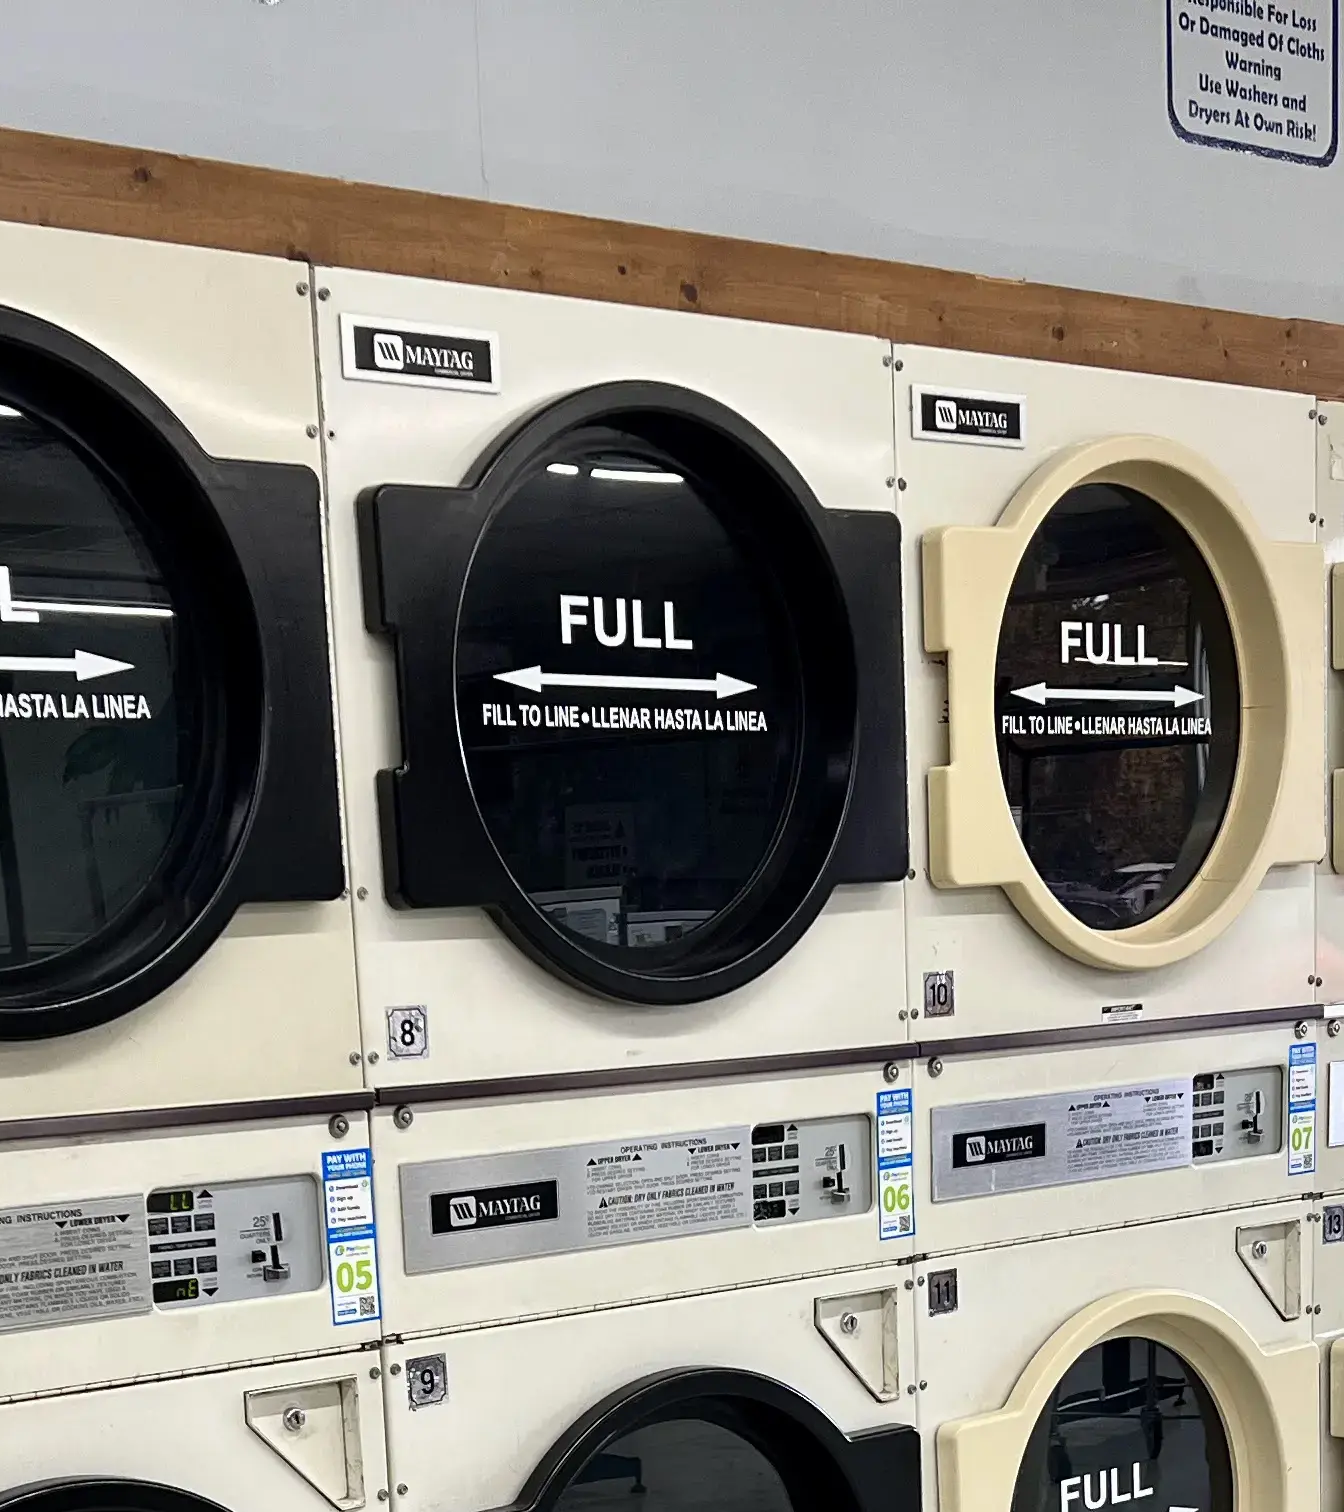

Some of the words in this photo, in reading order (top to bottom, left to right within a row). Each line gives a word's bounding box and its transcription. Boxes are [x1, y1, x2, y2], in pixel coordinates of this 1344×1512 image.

[1267, 4, 1289, 25] For
[1292, 9, 1317, 32] Loss
[1178, 12, 1196, 33] Or
[1200, 16, 1265, 49] Damaged
[1268, 32, 1284, 52] Of
[1287, 37, 1325, 62] Cloths
[1225, 50, 1282, 82] Warning
[1199, 73, 1222, 95] Use
[1226, 78, 1278, 107] Washers
[1282, 95, 1307, 113] and
[1188, 99, 1231, 125] Dryers
[1234, 109, 1250, 128] At
[1253, 113, 1283, 136] Own
[1286, 119, 1317, 143] Risk!
[406, 345, 473, 370] MAYTAG
[958, 409, 1007, 429] MAYTAG
[560, 594, 693, 650] FULL
[1061, 621, 1158, 666] FULL
[61, 694, 89, 719] LA
[92, 694, 151, 719] LINEA
[482, 703, 517, 726] FILL
[519, 704, 541, 727] TO
[544, 705, 580, 728] LINE
[591, 706, 652, 729] LLENAR
[654, 708, 703, 730] HASTA
[705, 710, 723, 731] LA
[726, 710, 768, 732] LINEA
[1002, 715, 1026, 734] FILL
[1029, 716, 1045, 734] TO
[1048, 716, 1073, 734] LINE
[1081, 716, 1126, 735] LLENAR
[1128, 717, 1164, 735] HASTA
[1165, 717, 1180, 735] LA
[1181, 717, 1212, 735] LINEA
[929, 983, 948, 1007] 10
[399, 1019, 415, 1049] 8
[987, 1135, 1033, 1154] MAYTAG
[1291, 1126, 1313, 1152] 07
[478, 1194, 541, 1217] MAYTAG
[883, 1184, 910, 1213] 06
[1327, 1214, 1341, 1235] 13
[336, 1260, 373, 1294] 05
[934, 1280, 953, 1304] 11
[421, 1369, 434, 1394] 9
